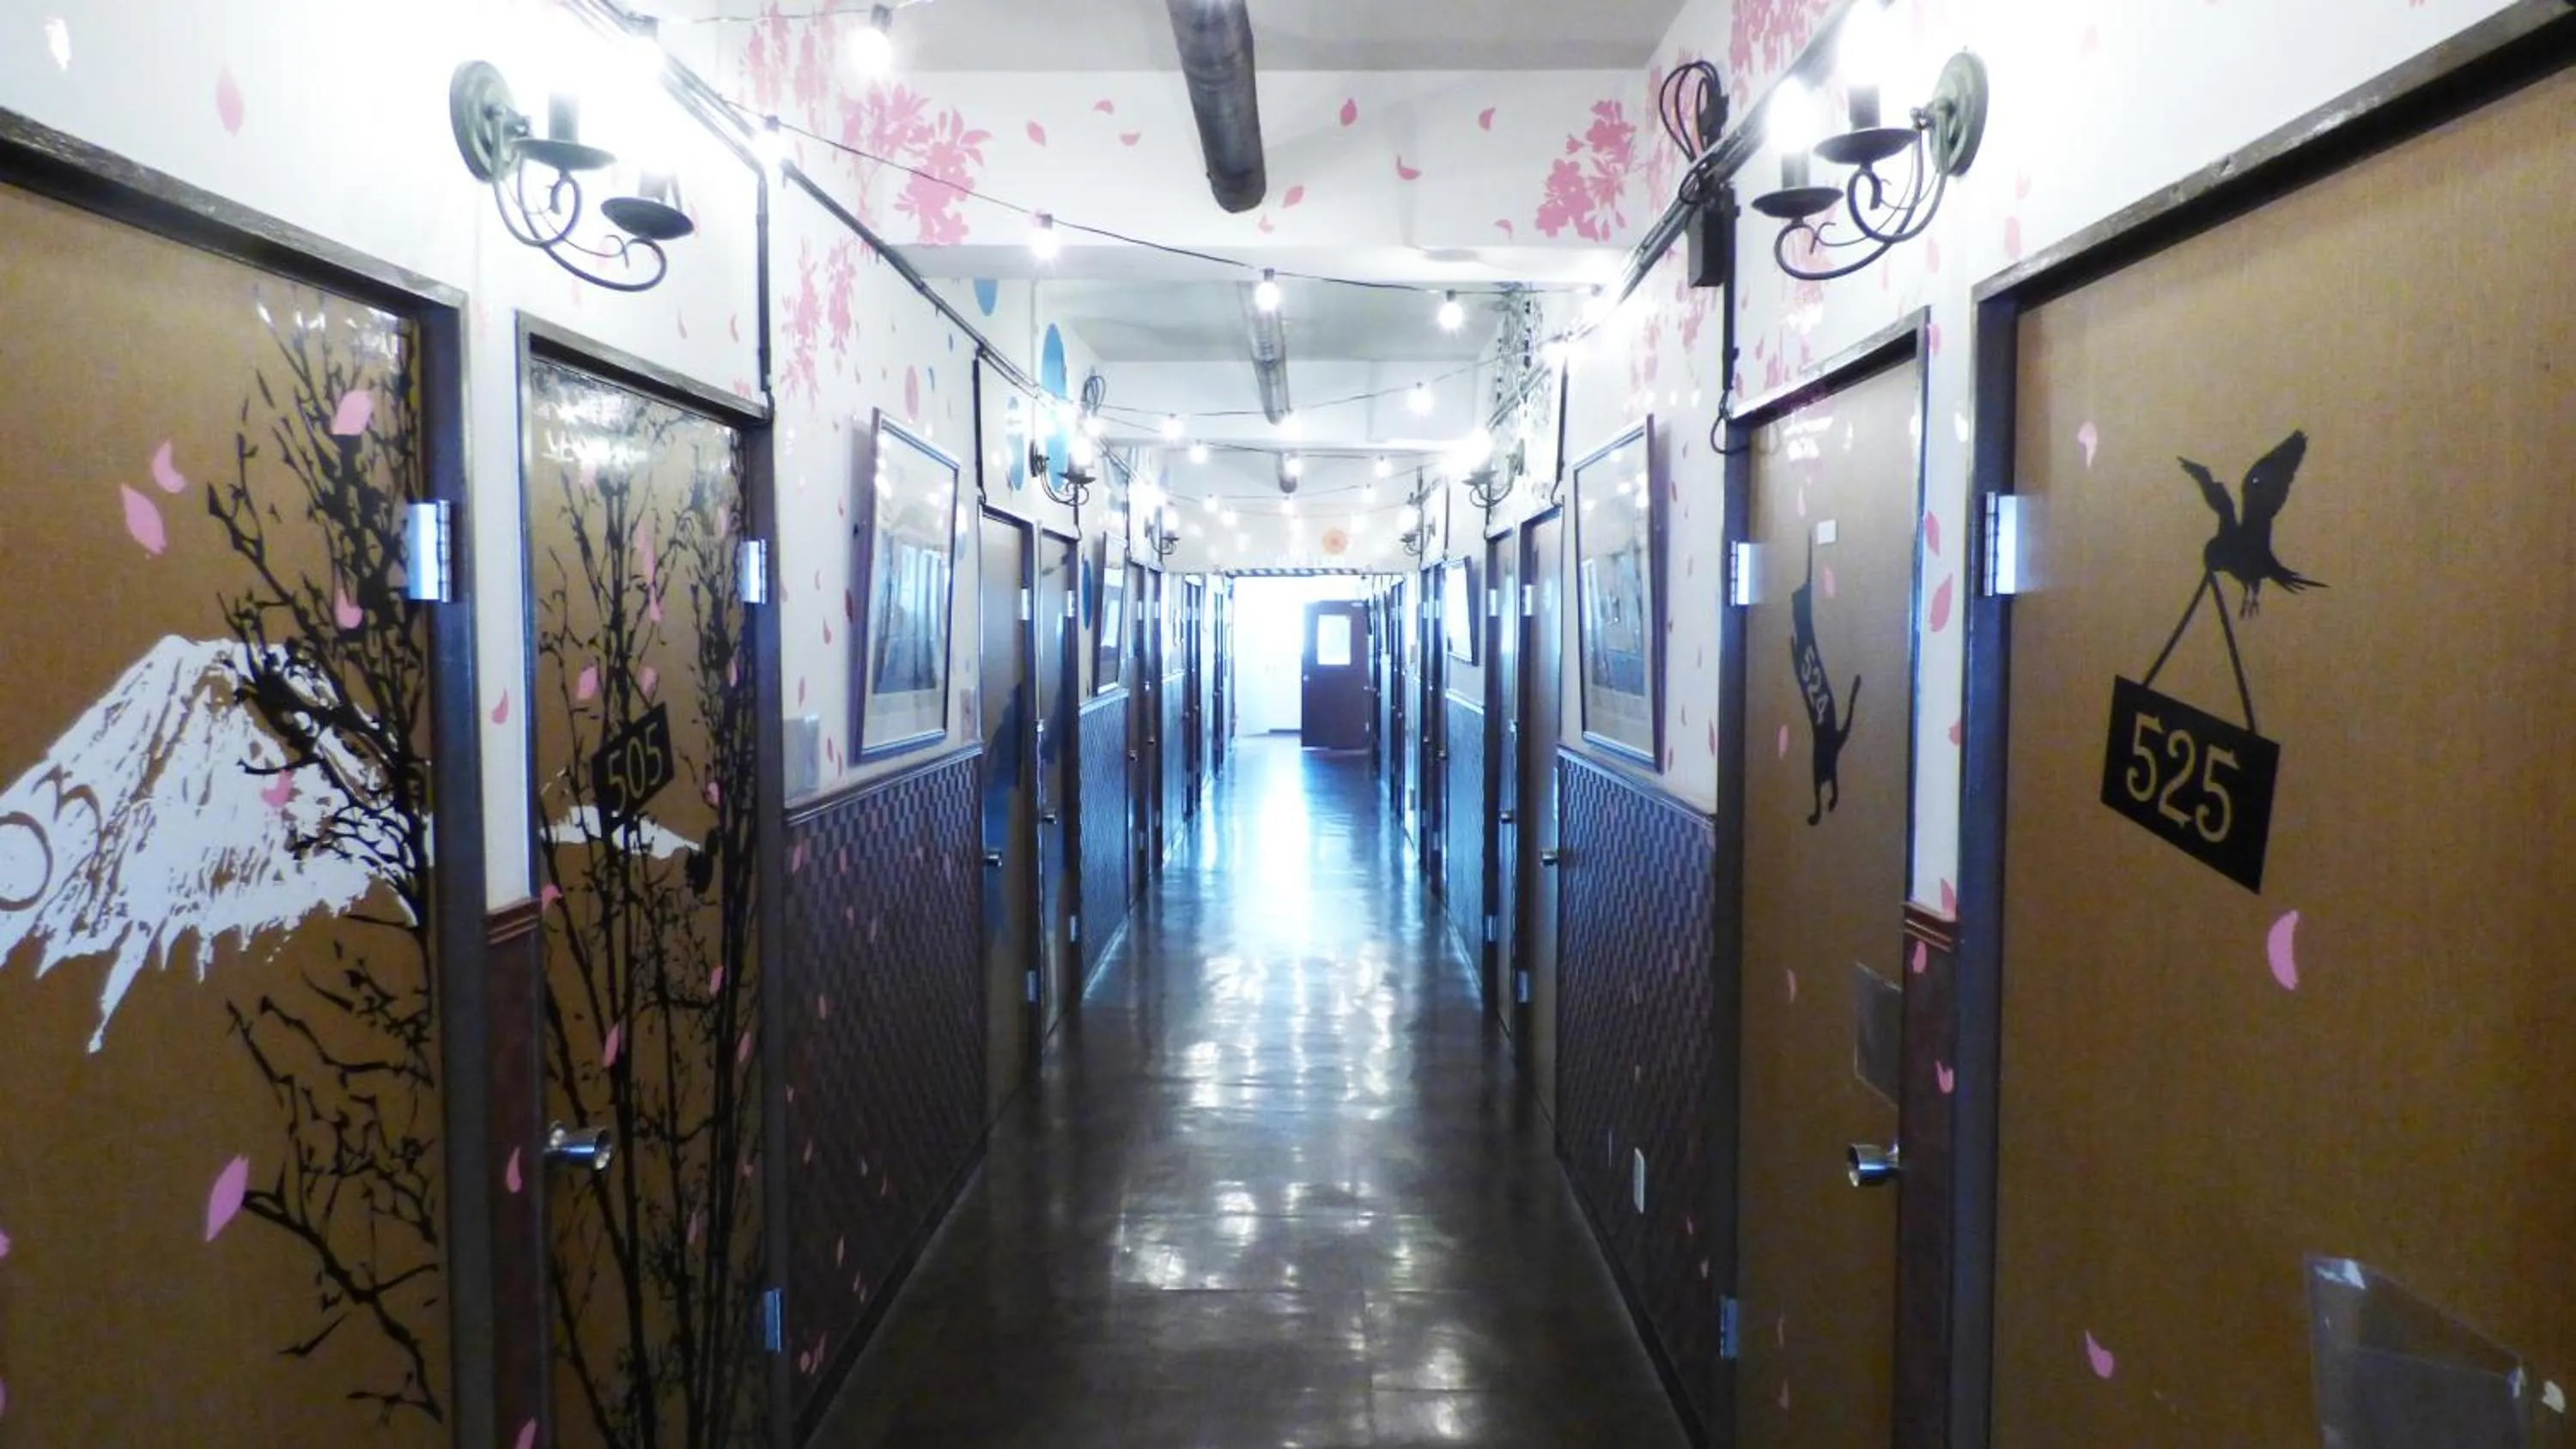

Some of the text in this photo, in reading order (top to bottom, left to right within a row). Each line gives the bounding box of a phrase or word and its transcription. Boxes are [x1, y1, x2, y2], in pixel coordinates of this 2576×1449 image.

[1801, 645, 1829, 724] 524
[608, 722, 662, 816] 505
[2126, 712, 2239, 843] 525
